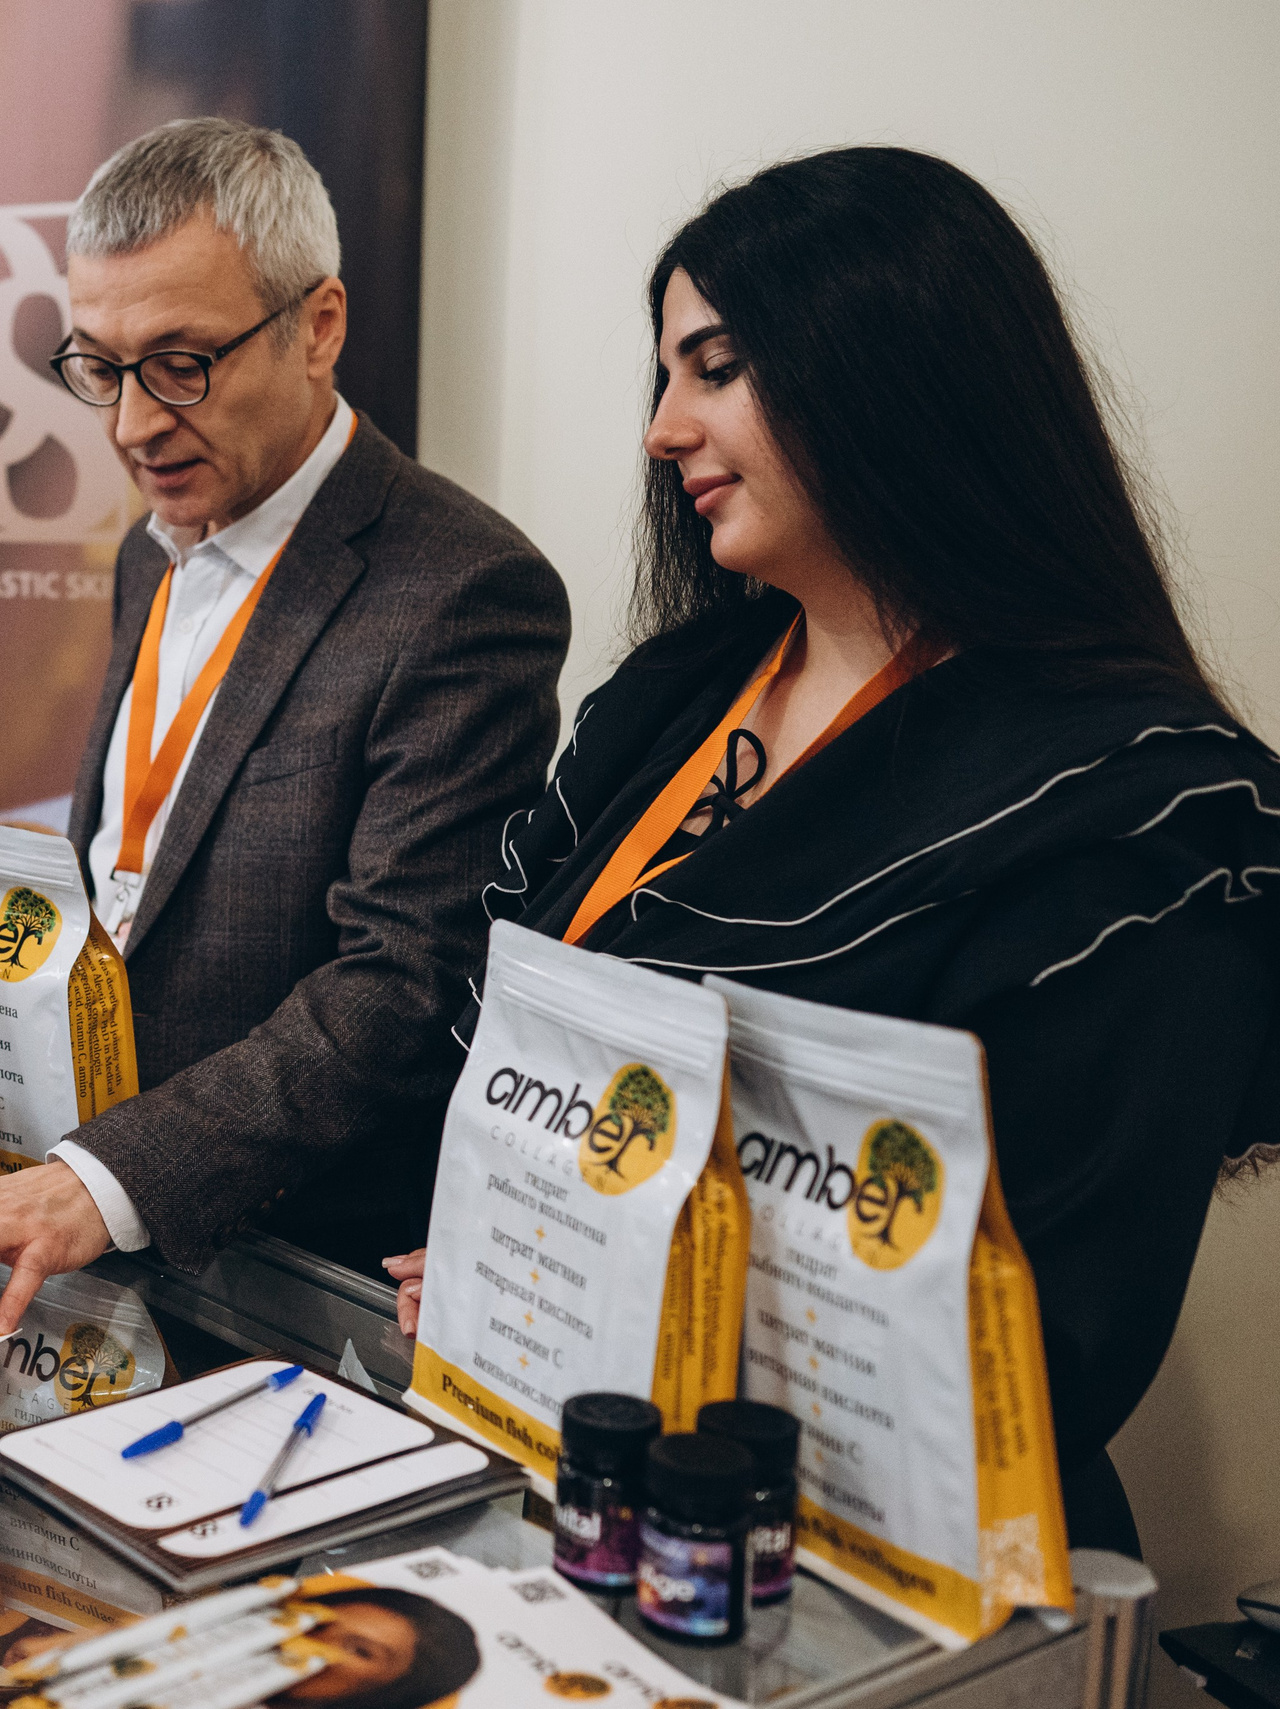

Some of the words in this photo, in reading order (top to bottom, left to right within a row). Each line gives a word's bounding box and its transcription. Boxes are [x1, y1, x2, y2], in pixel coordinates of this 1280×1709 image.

[98, 956, 110, 977] was
[74, 985, 84, 1011] acid,
[93, 973, 108, 1017] Alevtina,
[75, 1011, 86, 1052] vitamin
[91, 1007, 102, 1079] cosmetologist.
[101, 1019, 110, 1042] PhD
[110, 1029, 121, 1061] jointly
[77, 1052, 87, 1064] C,
[104, 1044, 111, 1055] in
[78, 1065, 88, 1098] amino
[105, 1056, 115, 1096] Medical
[114, 1064, 123, 1087] with
[485, 1066, 657, 1160] amber
[737, 1130, 924, 1232] amber
[441, 1372, 503, 1430] Premium
[506, 1416, 533, 1451] fish
[10, 1516, 66, 1547] витамин
[0, 1543, 98, 1590] аминокислоты
[45, 1584, 73, 1608] fish
